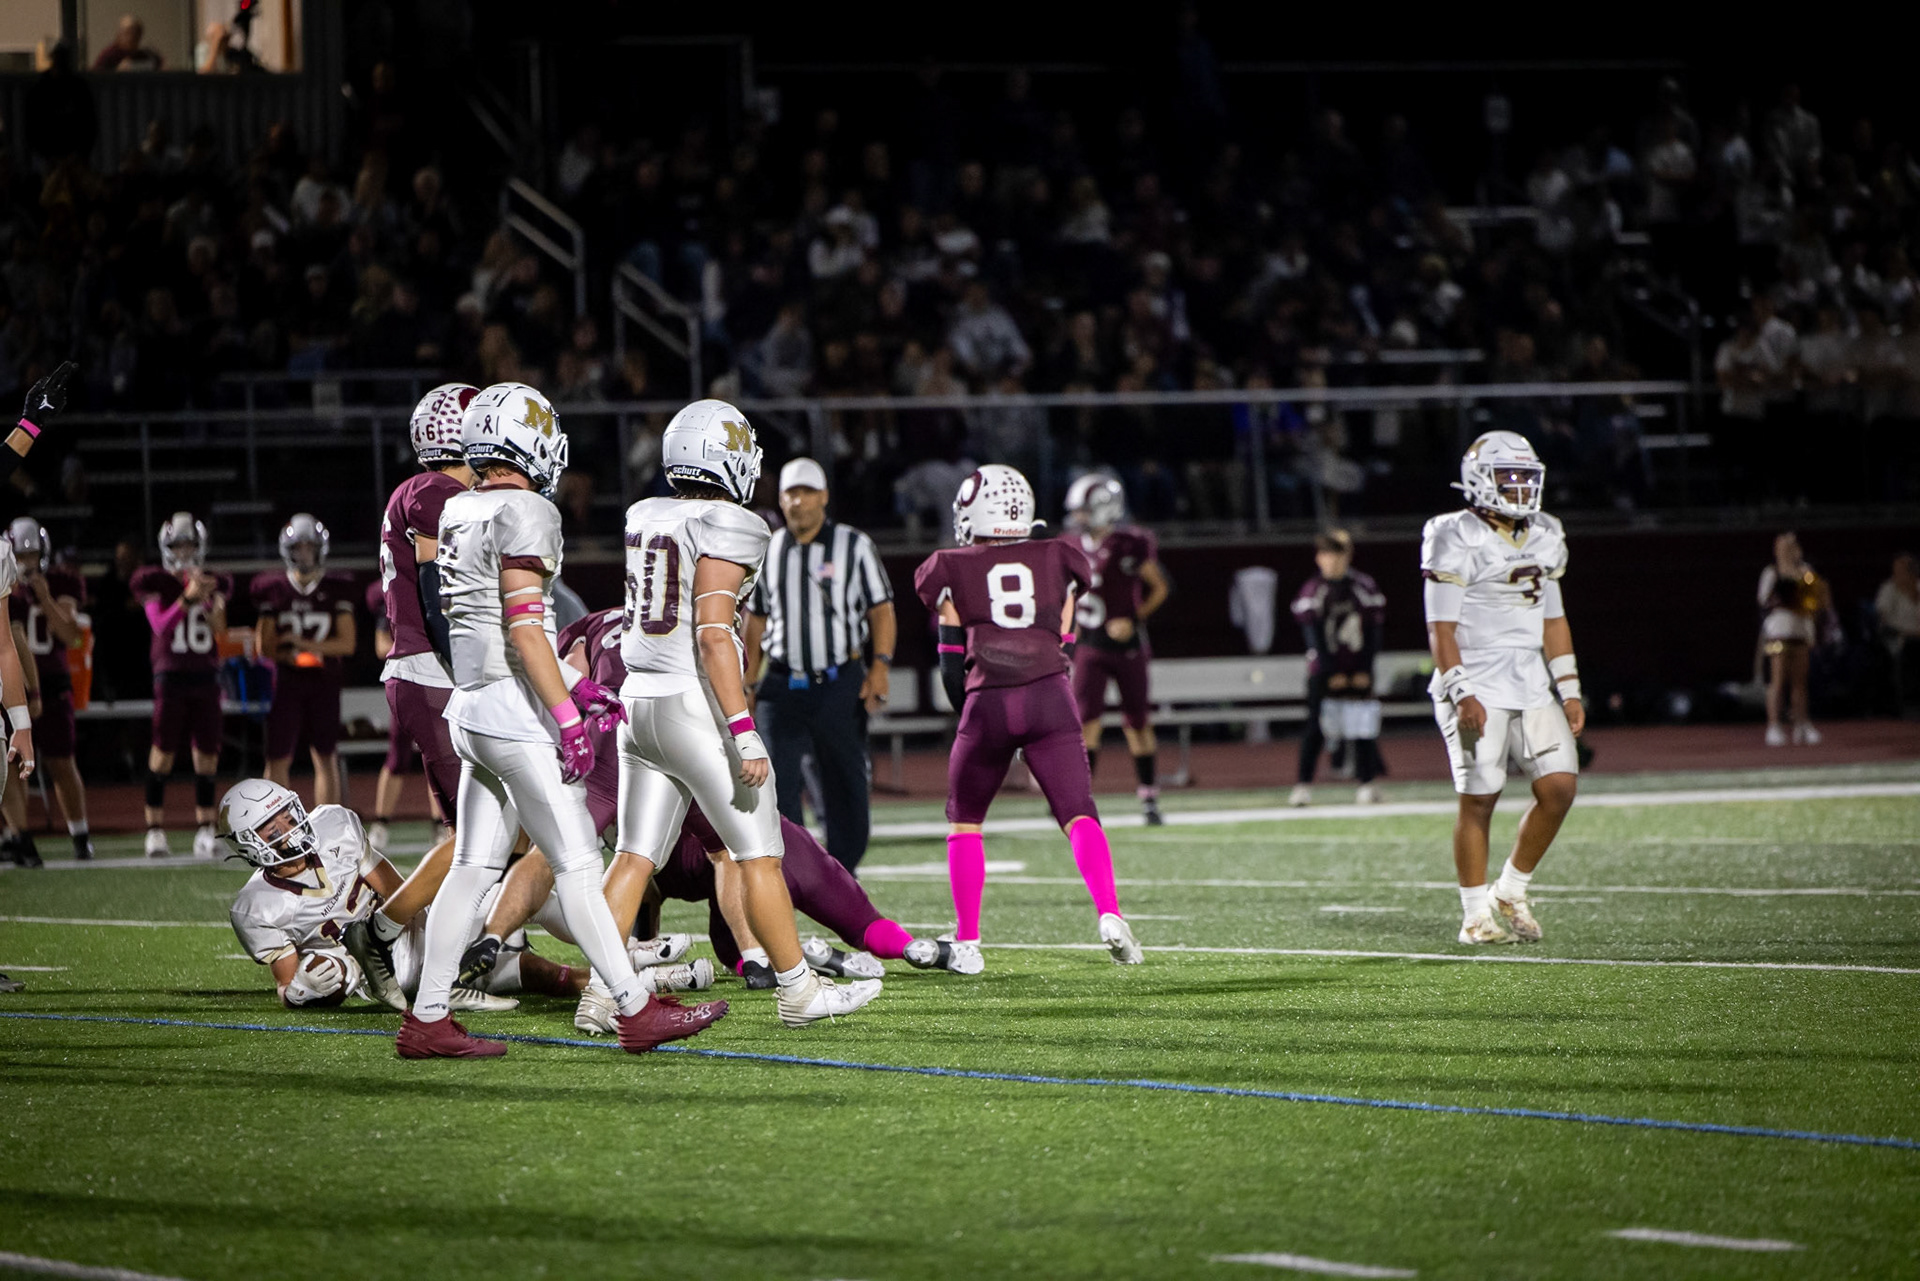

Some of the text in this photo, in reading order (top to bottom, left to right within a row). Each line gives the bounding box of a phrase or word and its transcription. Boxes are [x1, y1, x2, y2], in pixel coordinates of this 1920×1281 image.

[467, 444, 495, 455] schutt
[672, 465, 702, 477] schutt
[1010, 505, 1018, 520] 8
[986, 563, 1036, 629] 8
